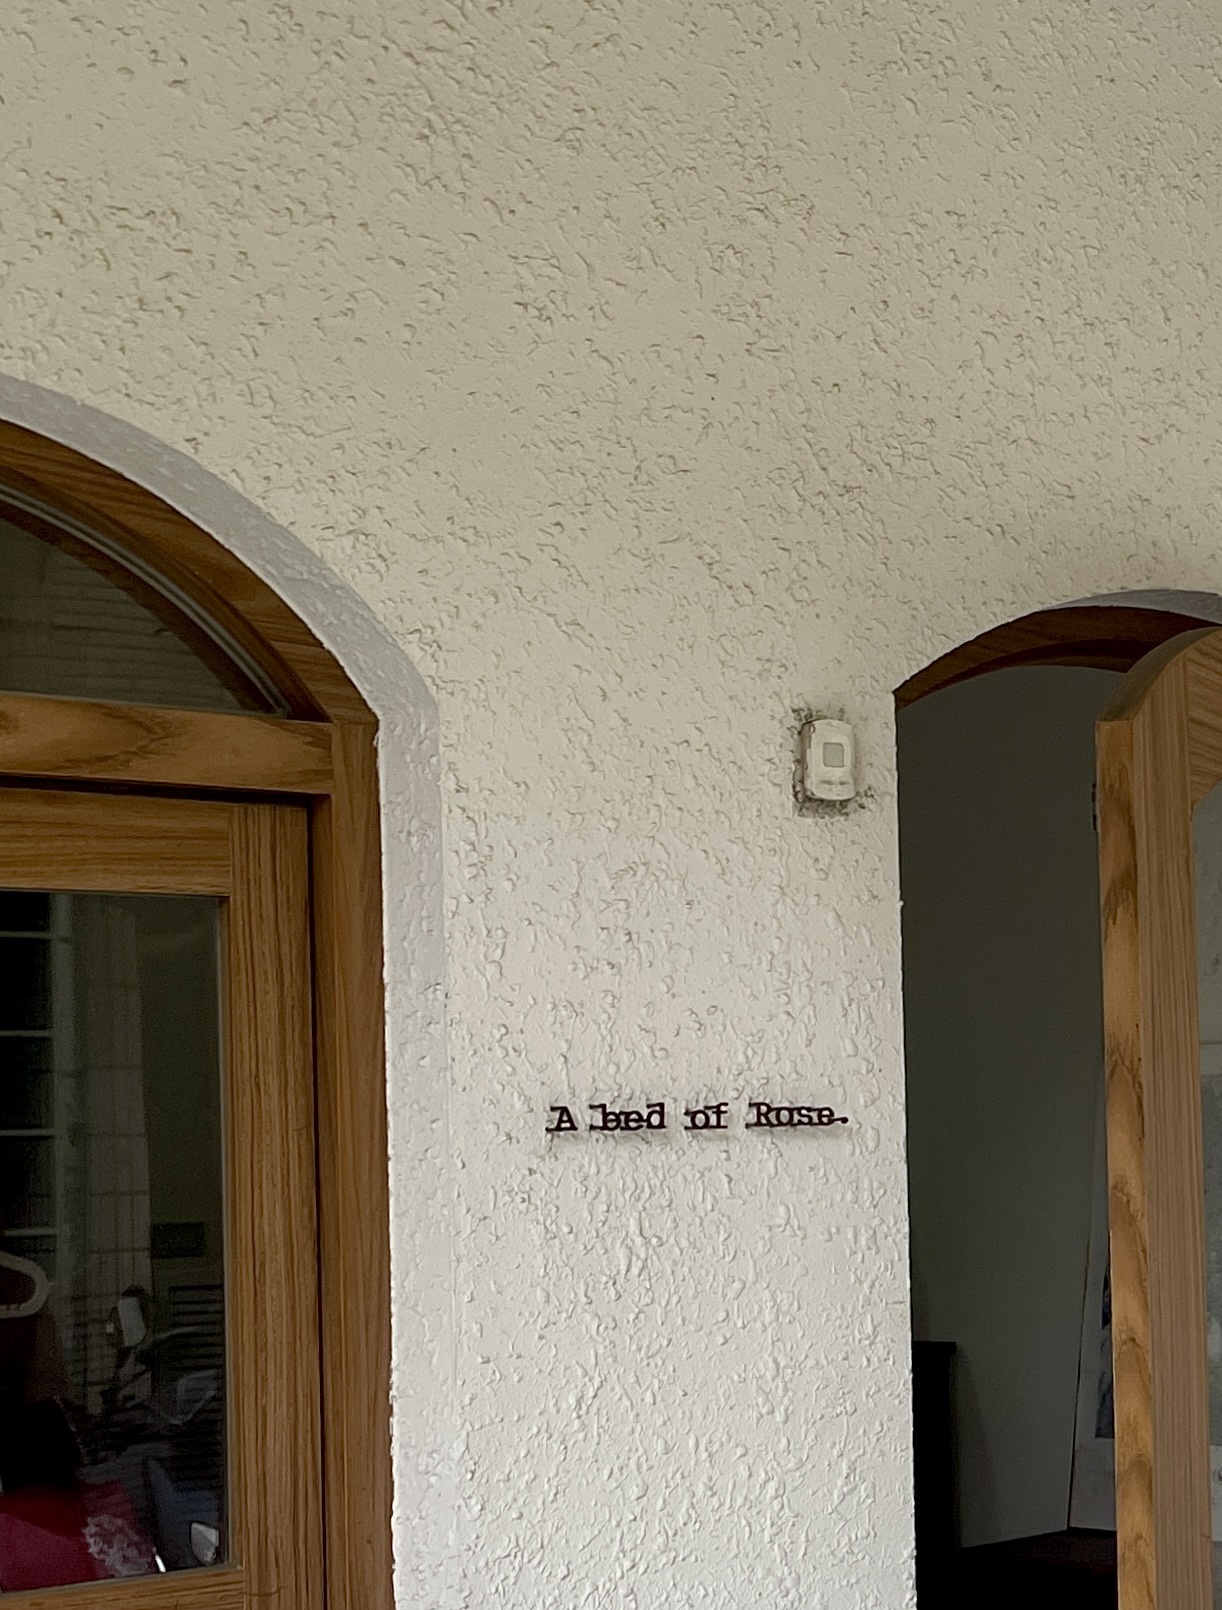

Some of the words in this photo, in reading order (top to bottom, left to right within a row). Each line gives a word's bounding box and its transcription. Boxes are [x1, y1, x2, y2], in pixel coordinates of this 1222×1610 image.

[546, 1106, 578, 1132] A
[589, 1102, 666, 1131] bed
[684, 1102, 729, 1130] of
